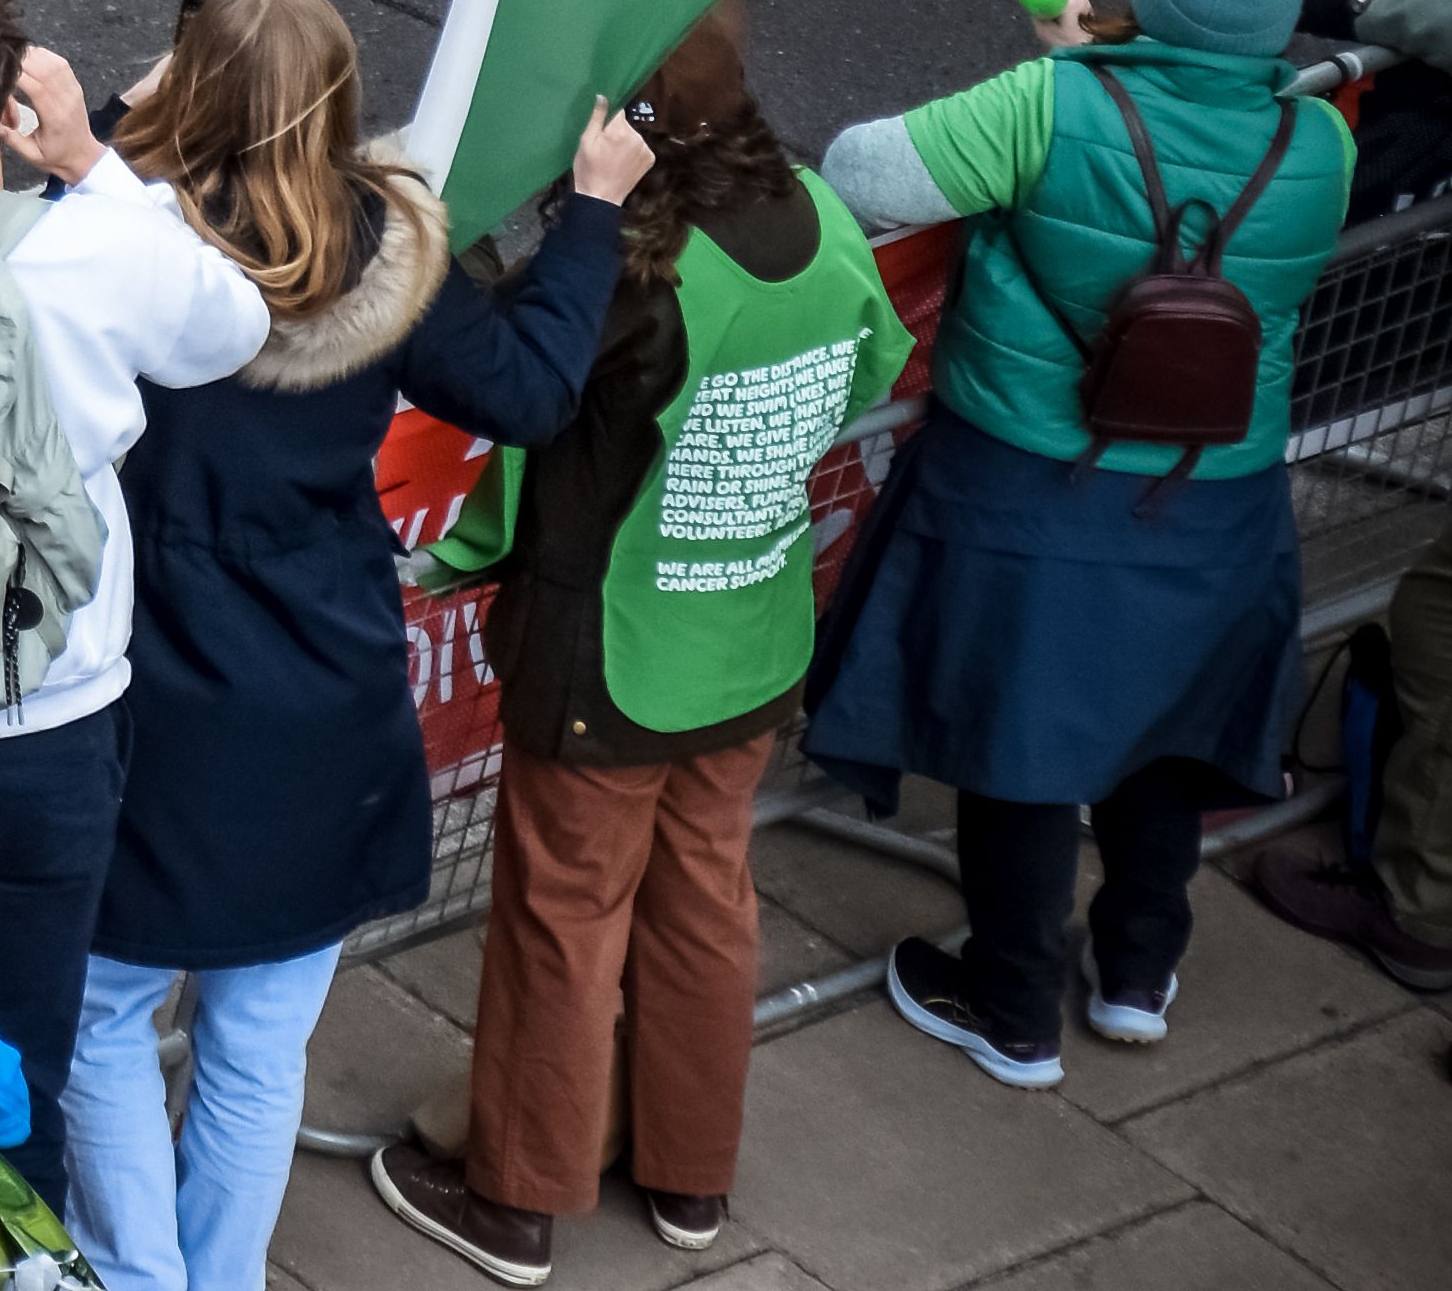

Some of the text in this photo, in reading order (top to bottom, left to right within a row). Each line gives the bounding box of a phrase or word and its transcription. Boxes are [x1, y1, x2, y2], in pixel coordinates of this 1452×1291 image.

[711, 372, 739, 388] GO
[741, 367, 769, 386] THE
[771, 346, 831, 381] DISTANCE.
[832, 340, 856, 357] WE
[735, 377, 794, 403] HEIGHTS
[795, 367, 815, 387] WE
[716, 402, 744, 417] WE
[746, 394, 788, 417] SWIM
[705, 417, 766, 434] LISTEN.
[769, 411, 793, 428] WE
[726, 432, 754, 449] WE
[756, 428, 791, 446] GIVE
[736, 446, 763, 463] WE
[667, 463, 715, 479] HERE
[717, 457, 797, 479] THROUGH
[666, 477, 714, 494] RAIN
[716, 480, 742, 495] OR
[744, 474, 792, 494] SHINE.
[657, 561, 687, 576] WE
[689, 562, 725, 577] ARE
[726, 559, 754, 576] ALL
[656, 576, 729, 593] CANCER
